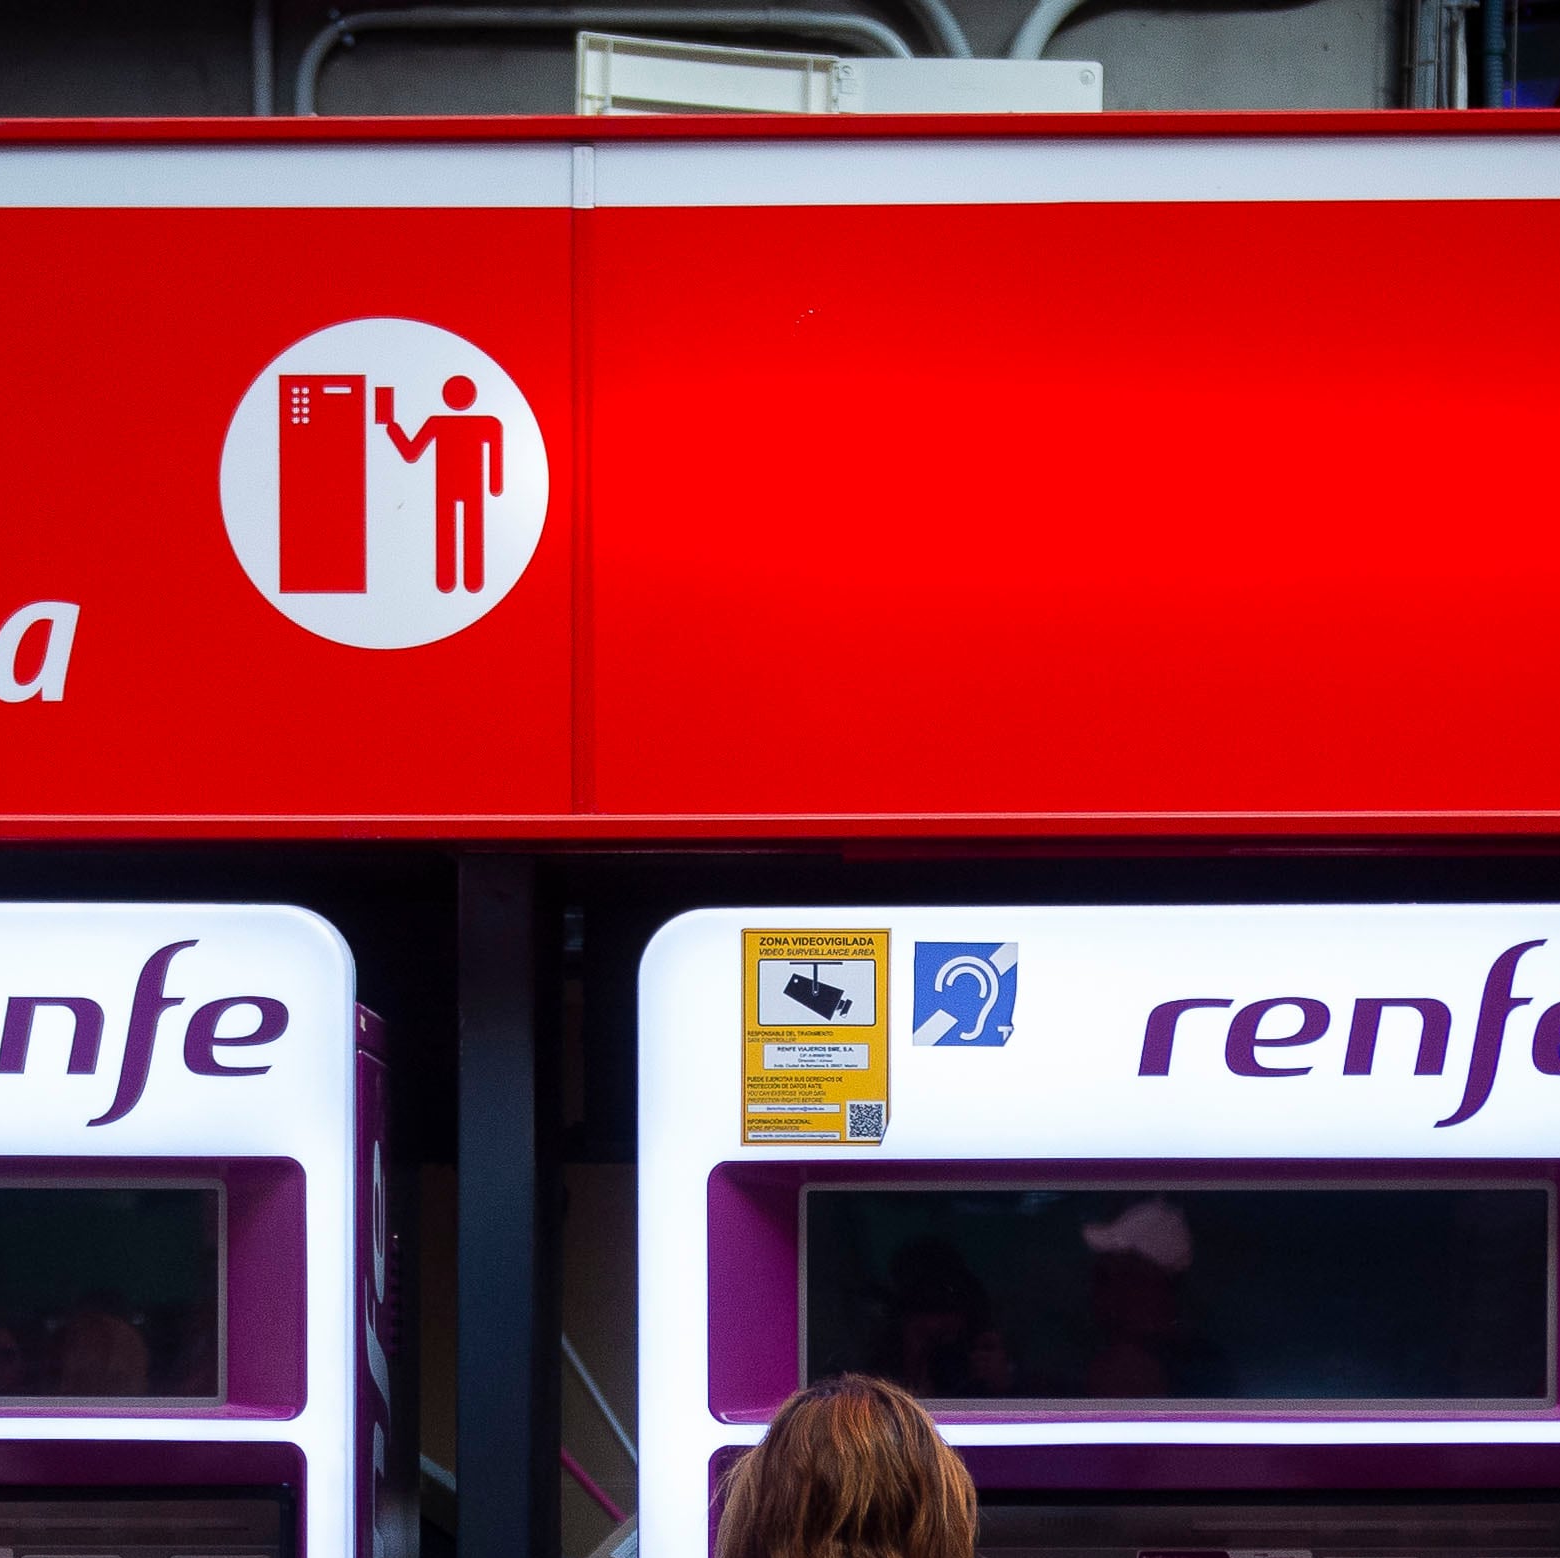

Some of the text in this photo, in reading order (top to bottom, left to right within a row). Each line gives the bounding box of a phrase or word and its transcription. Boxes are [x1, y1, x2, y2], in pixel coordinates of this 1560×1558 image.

[759, 937, 875, 946] ZONA VIDEOVIGILADA
[759, 948, 875, 956] VIDEO SURVEILLANCE AREA
